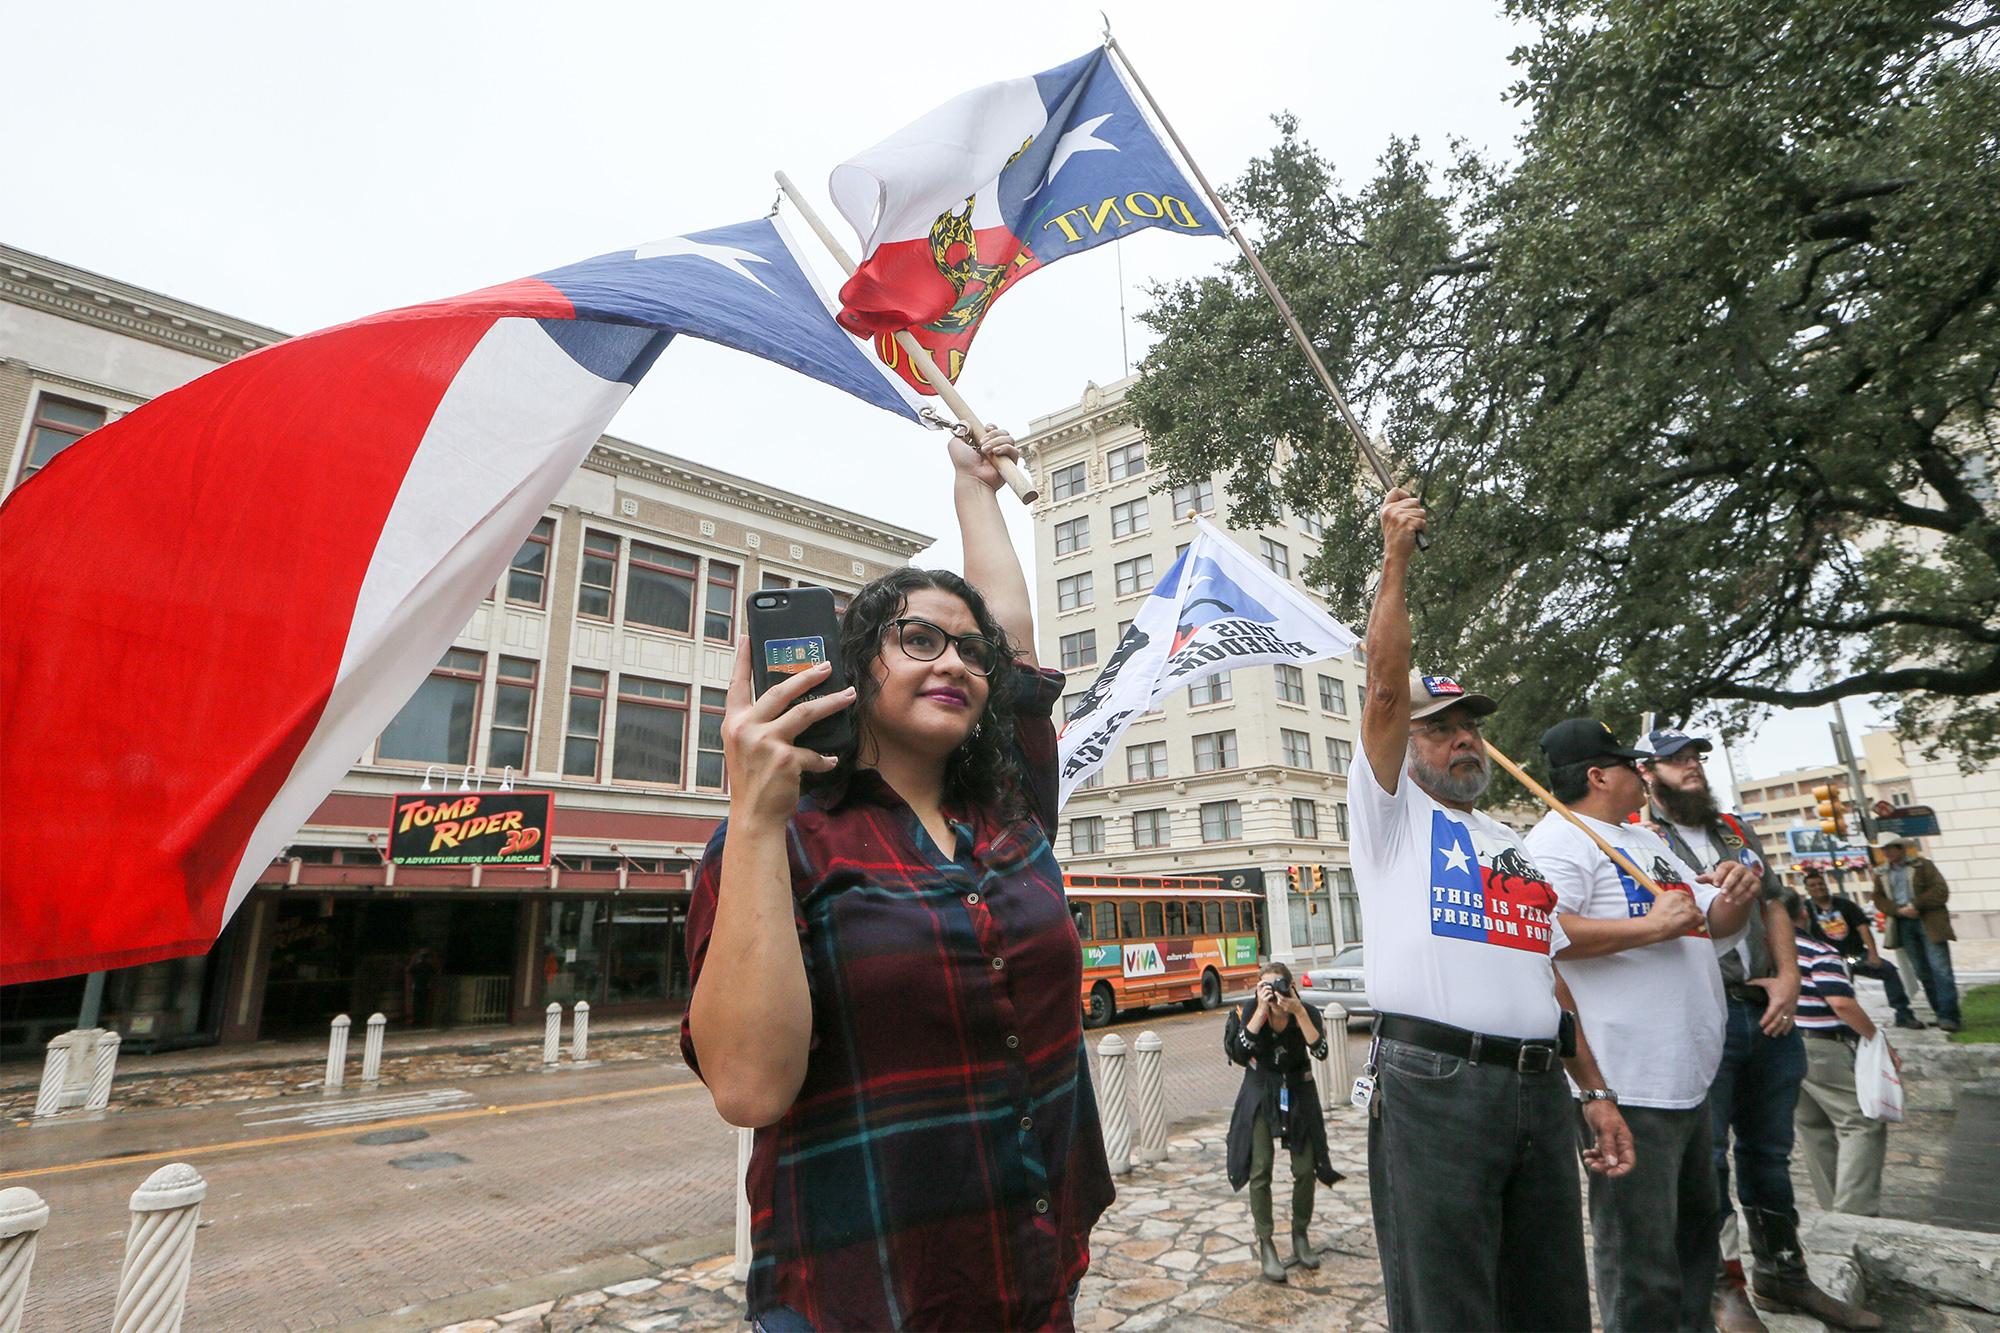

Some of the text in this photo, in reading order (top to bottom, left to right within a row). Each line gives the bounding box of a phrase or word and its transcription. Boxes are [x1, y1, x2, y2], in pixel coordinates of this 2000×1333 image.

[399, 796, 481, 834] TOMB
[430, 810, 524, 853] RIDER
[498, 827, 541, 857] 3D
[461, 855, 482, 863] RIDE
[484, 855, 503, 863] AND
[502, 854, 541, 863] ARCADE
[1432, 886, 1552, 925] THIS IS TEXA
[1432, 907, 1519, 936] FREEDOM
[1088, 948, 1101, 959] VIA
